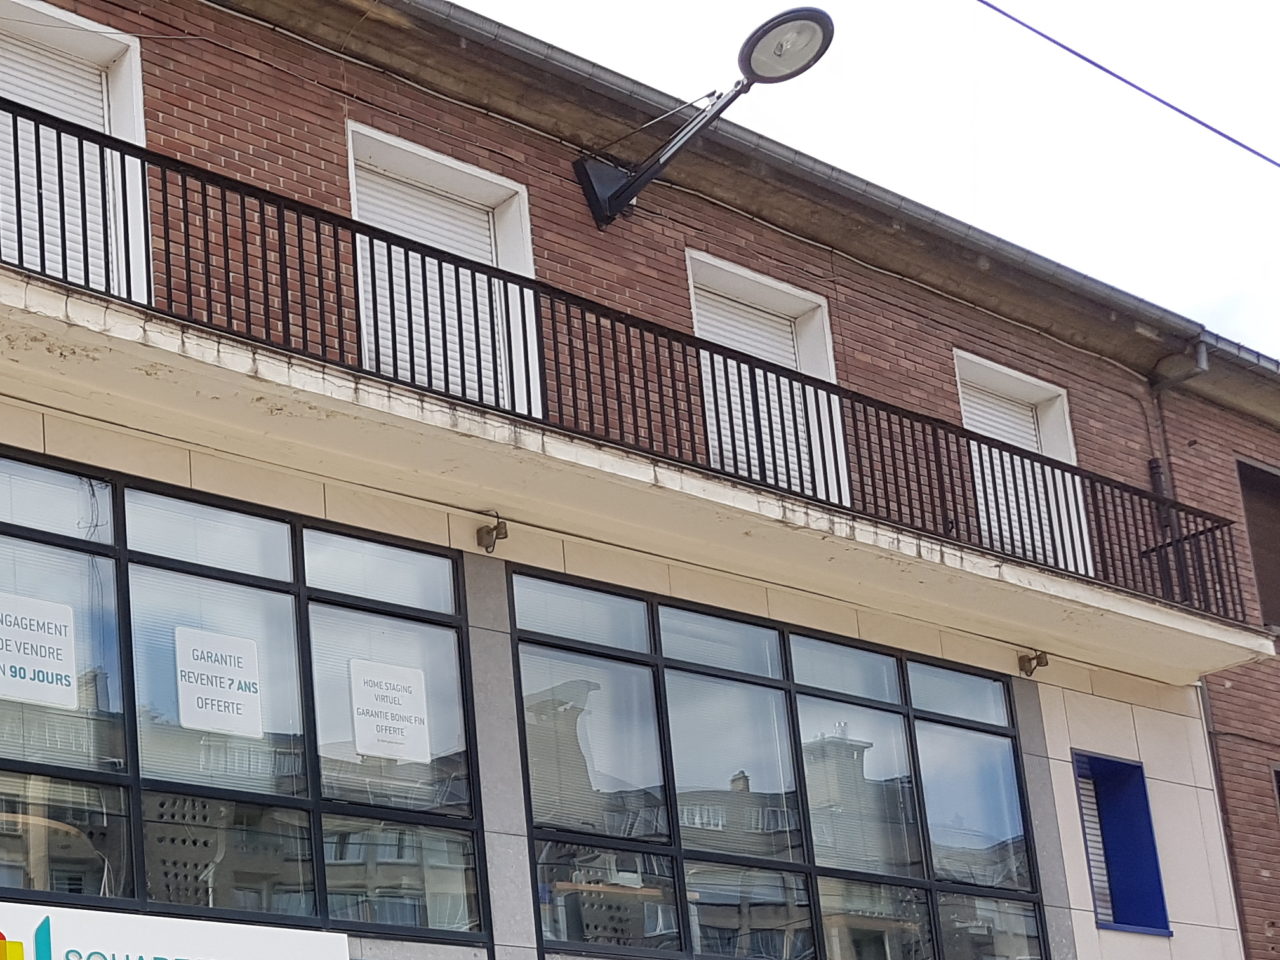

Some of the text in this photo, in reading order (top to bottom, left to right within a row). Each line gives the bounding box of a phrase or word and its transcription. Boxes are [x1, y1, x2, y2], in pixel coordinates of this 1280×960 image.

[14, 640, 63, 661] VENDRE
[192, 648, 244, 669] GARANTIE
[9, 664, 27, 680] 90
[29, 668, 72, 687] JOURS
[180, 669, 259, 694] REVENTE 7 ANS
[363, 679, 413, 695] HOME STAGING
[196, 696, 243, 715] OFFERTE
[374, 693, 403, 706] VIRTUEL
[356, 707, 425, 726] GARANTIE BONNE FIN
[375, 724, 405, 737] OFFERTE
